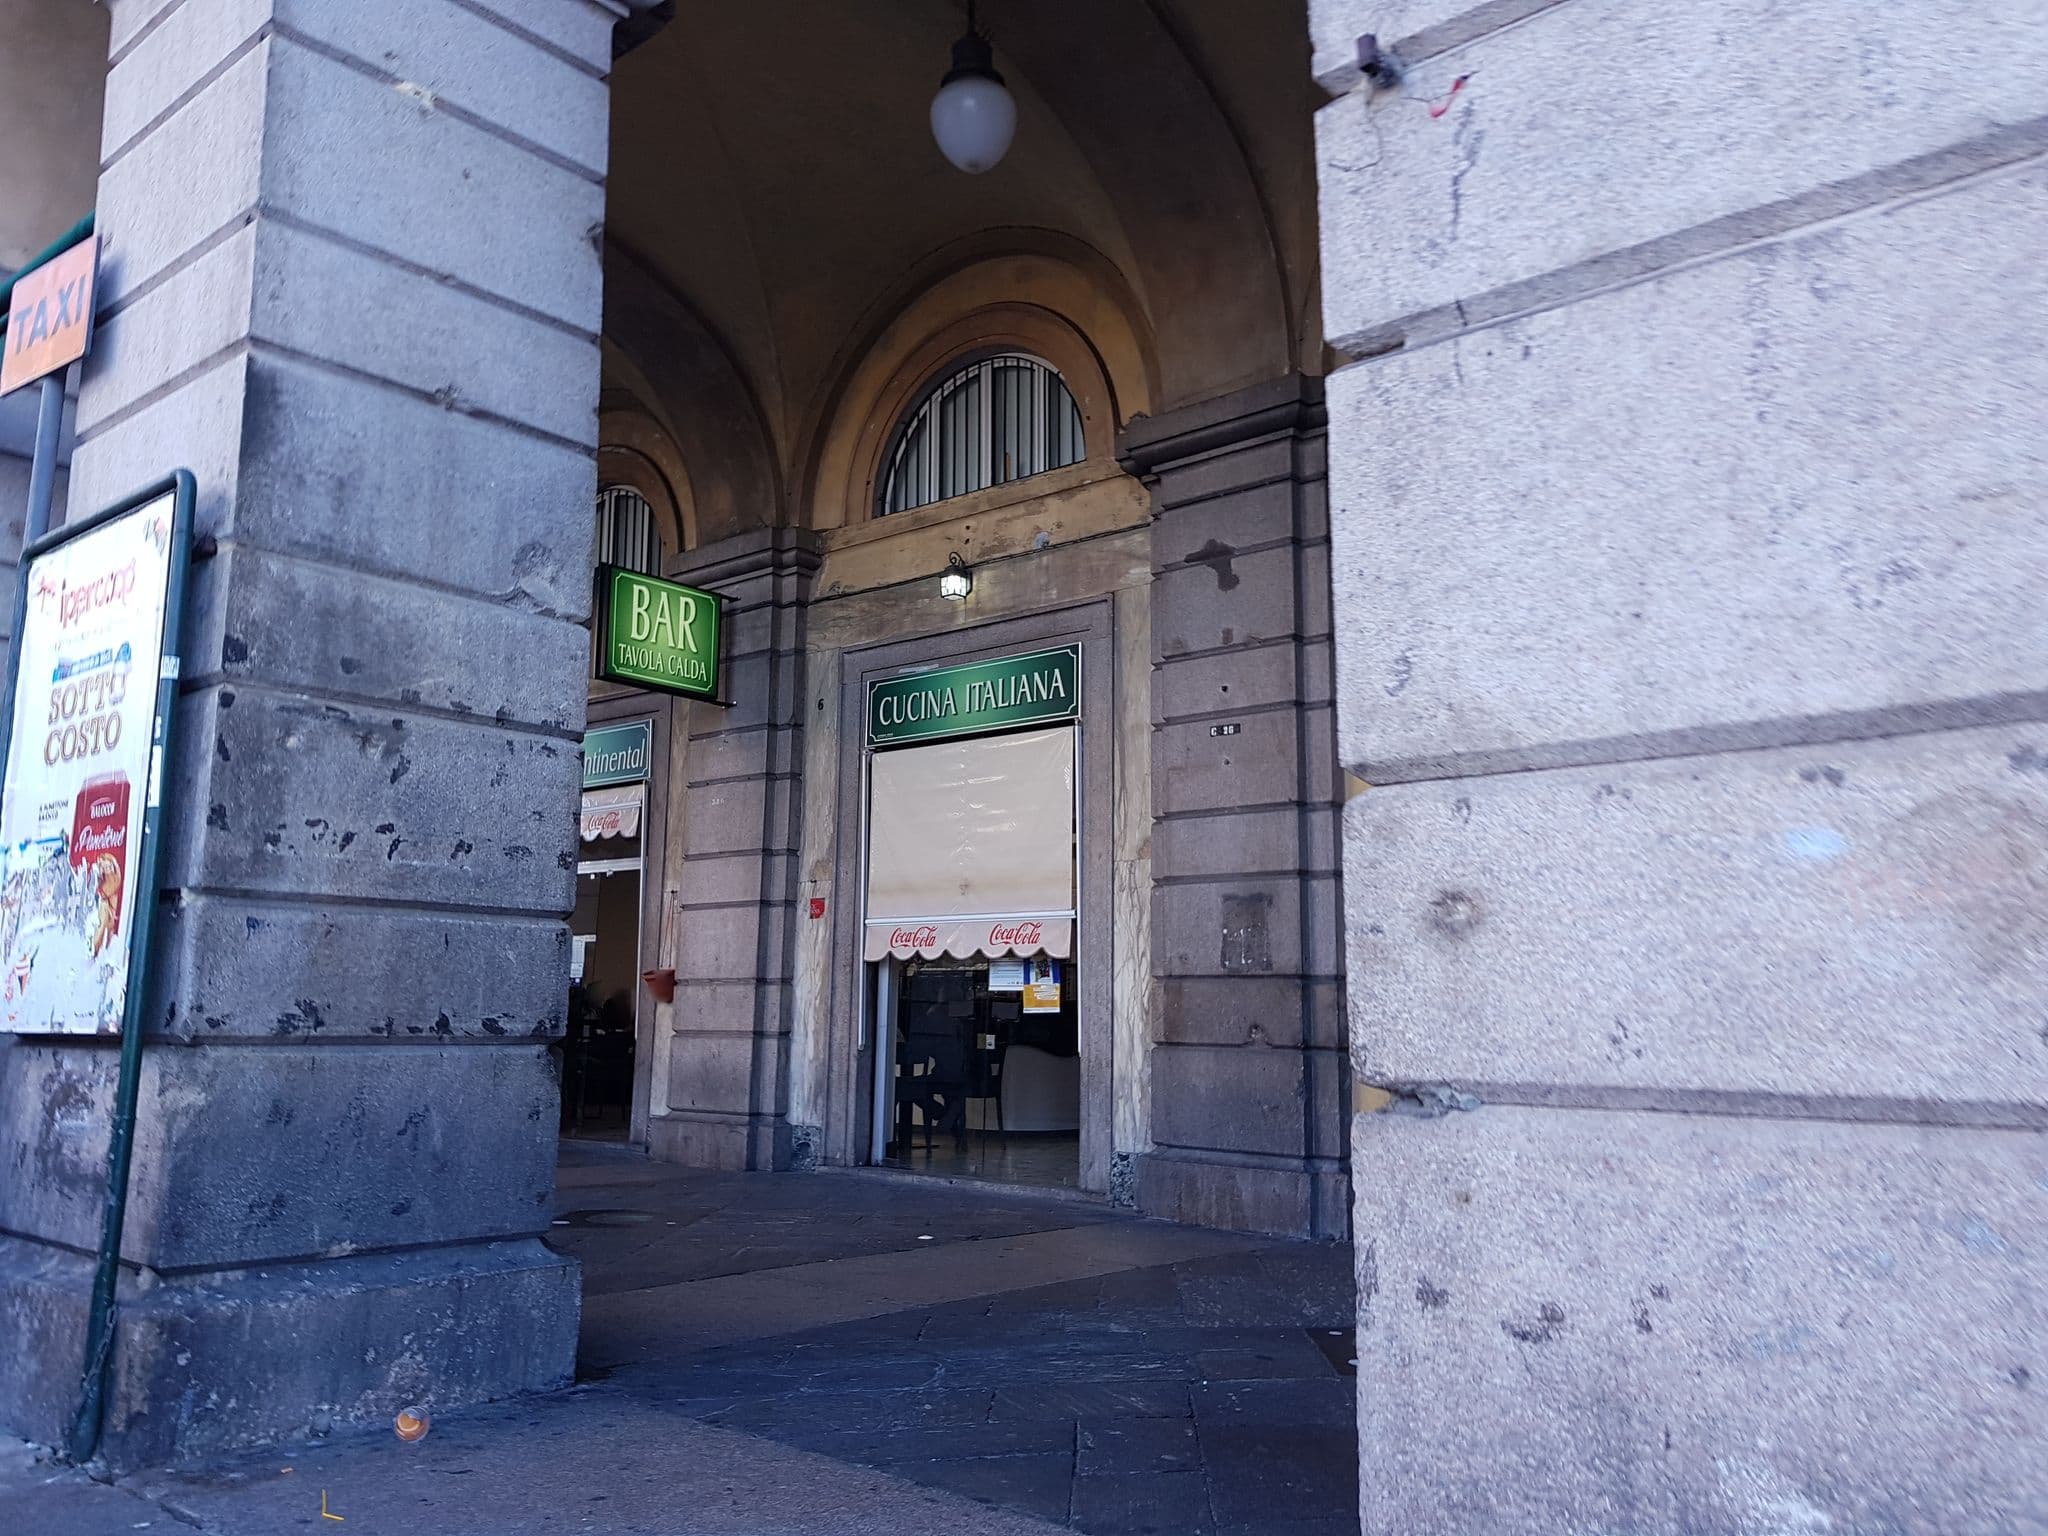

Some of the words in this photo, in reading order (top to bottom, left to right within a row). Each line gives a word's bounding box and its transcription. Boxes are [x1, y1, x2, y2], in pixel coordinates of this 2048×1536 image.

[14, 275, 86, 354] TAXI
[631, 584, 698, 653] BAR
[618, 642, 664, 673] TAVOLA
[668, 654, 708, 682] CALDA
[48, 668, 128, 725] SOTTO
[878, 687, 957, 726] CUCINA
[964, 667, 1066, 713] ITALIANA
[44, 711, 122, 767] COSTO
[584, 738, 645, 776] ntinental
[890, 925, 939, 948] Coca-Cola
[988, 921, 1043, 946] Coca-Cola
